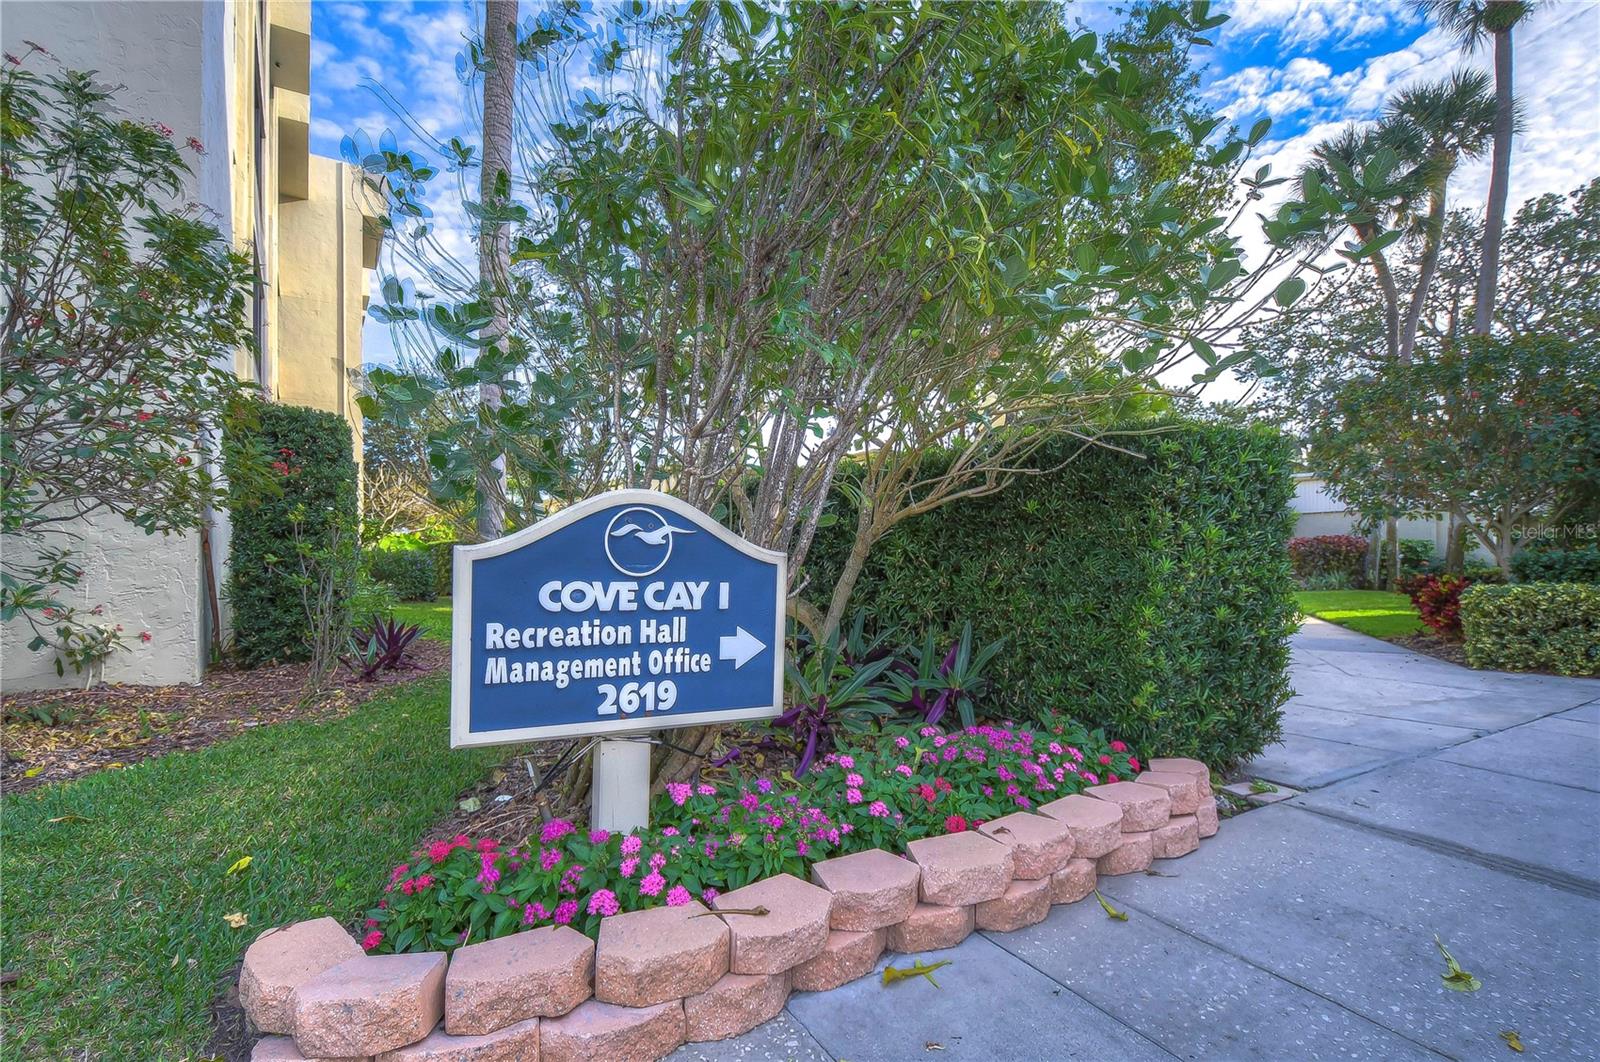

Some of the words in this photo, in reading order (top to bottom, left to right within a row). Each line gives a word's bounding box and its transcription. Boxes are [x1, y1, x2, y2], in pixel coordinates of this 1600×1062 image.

[538, 581, 639, 612] COVE
[644, 581, 710, 611] CAY
[719, 582, 730, 610] I
[485, 620, 631, 649] Recreation
[640, 616, 686, 644] Hall
[485, 651, 641, 689] Management
[648, 648, 711, 675] Office
[597, 680, 678, 715] 2619
